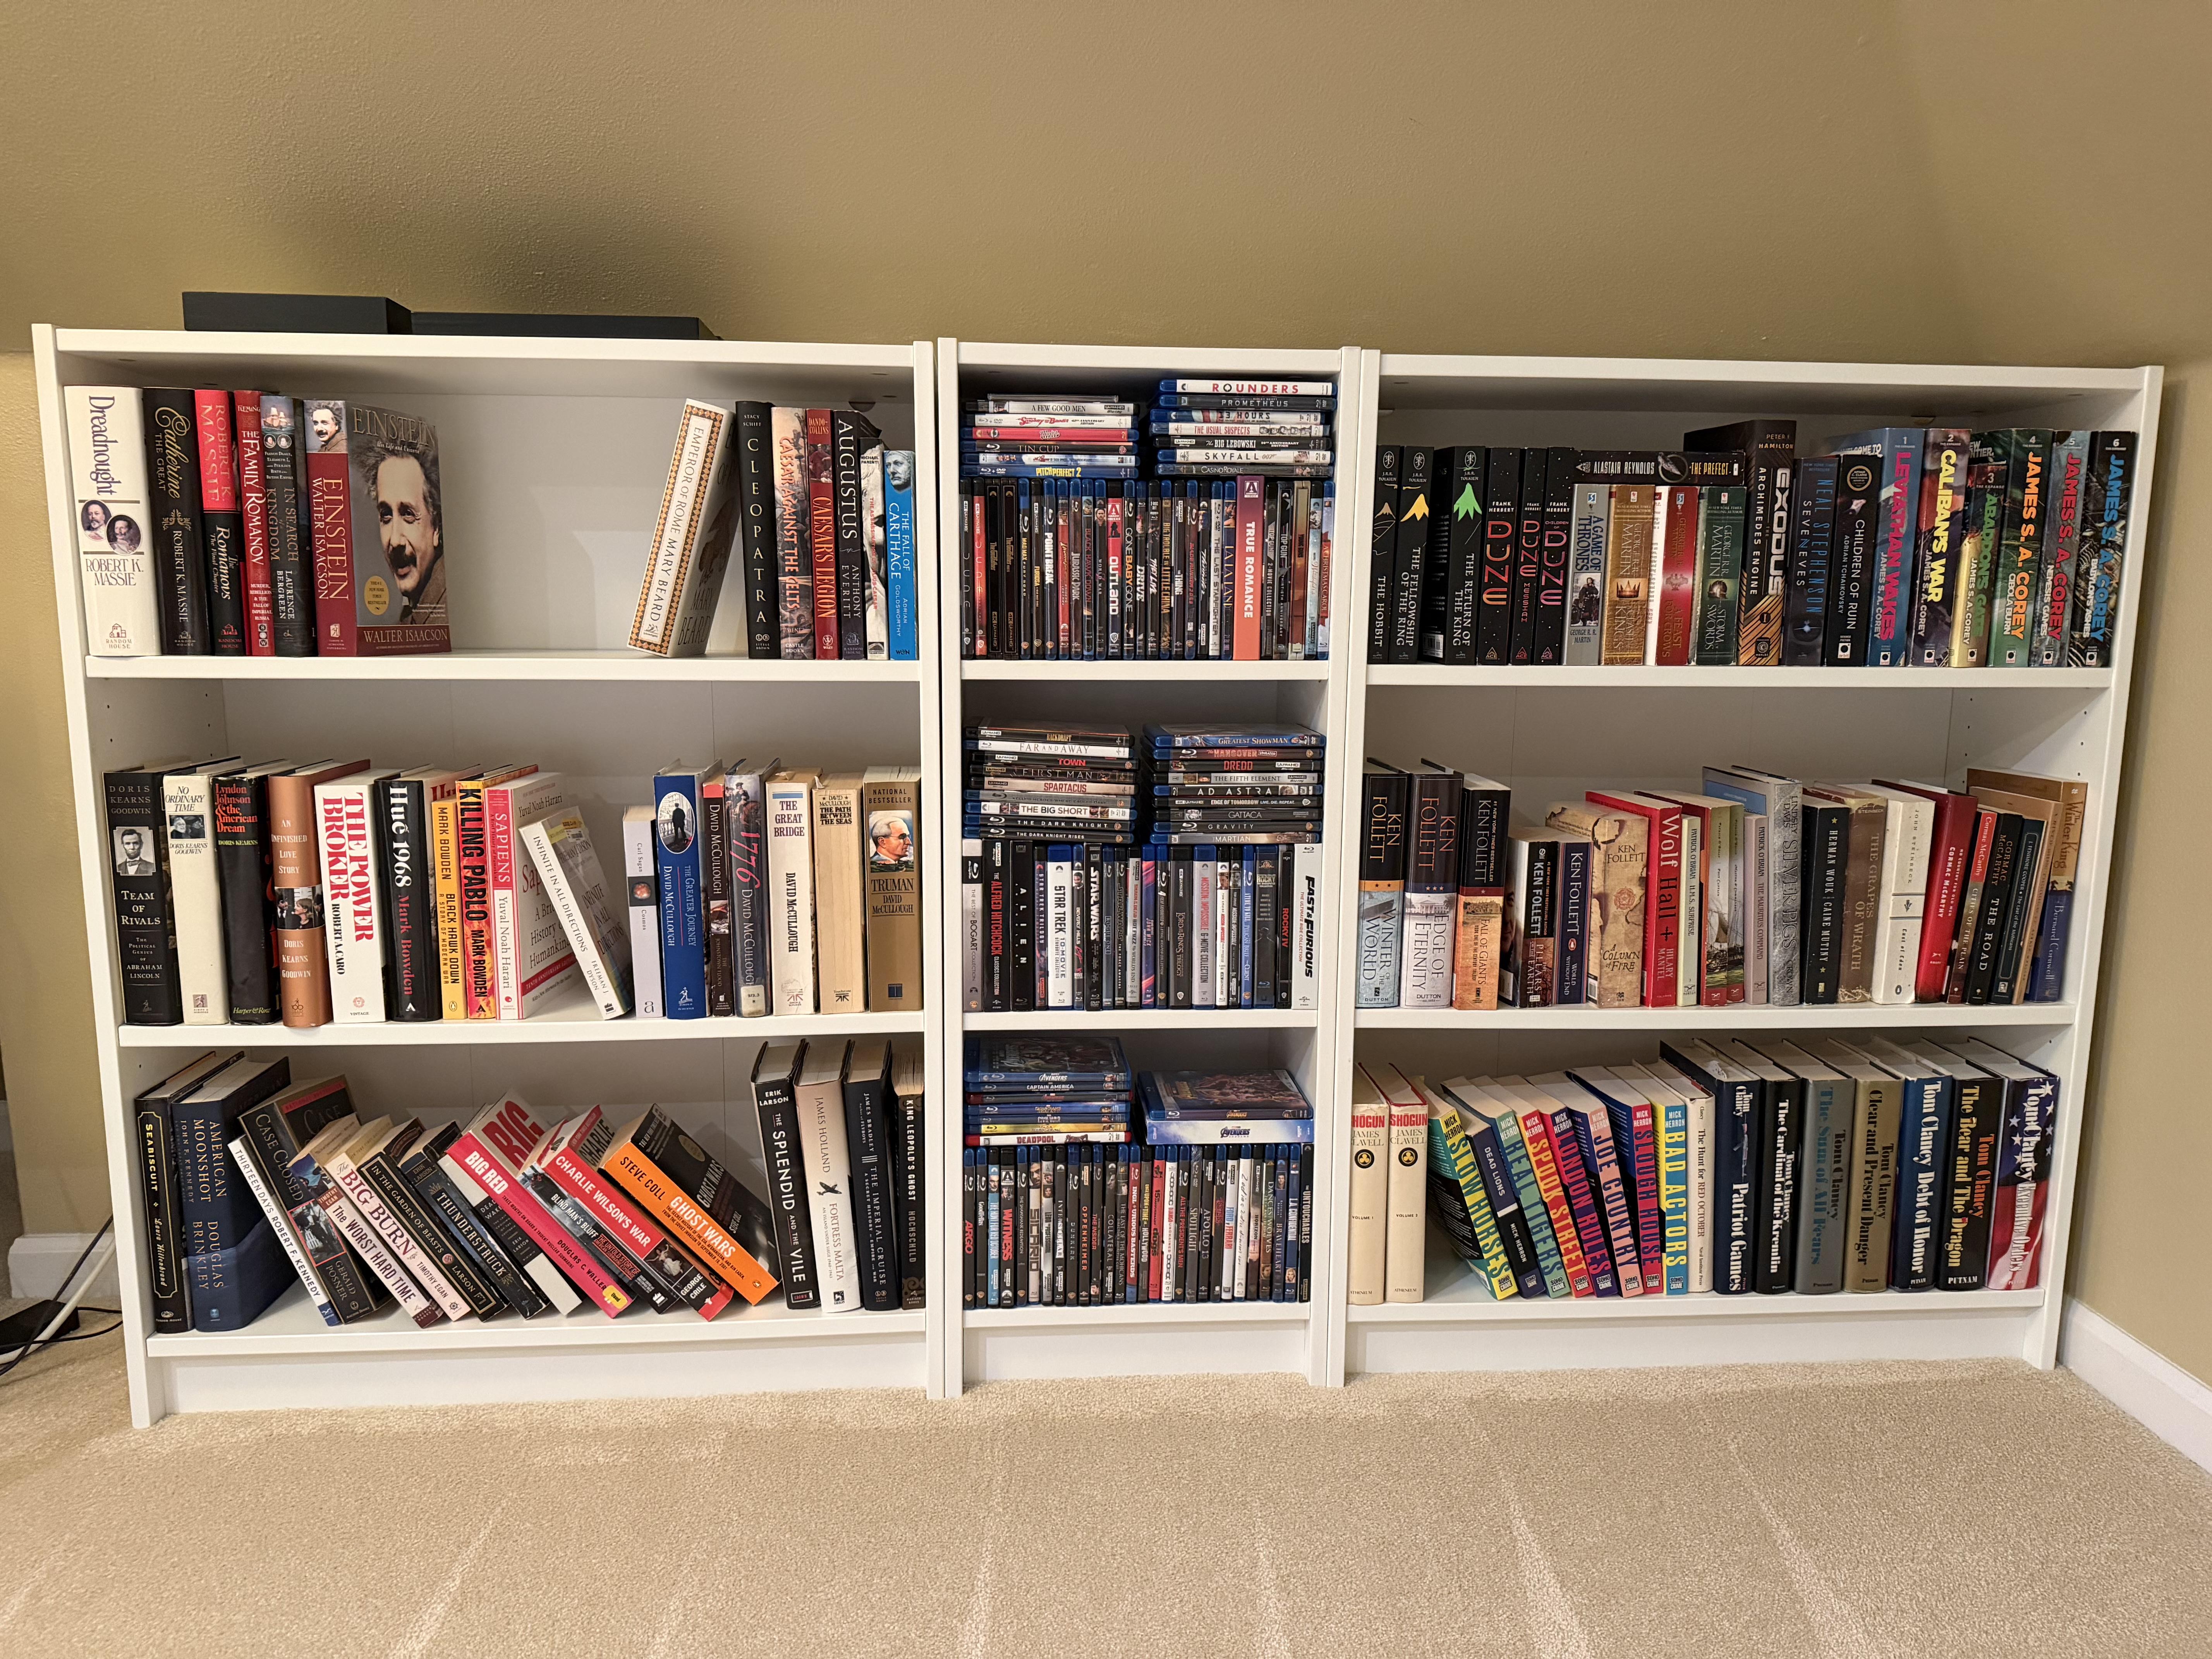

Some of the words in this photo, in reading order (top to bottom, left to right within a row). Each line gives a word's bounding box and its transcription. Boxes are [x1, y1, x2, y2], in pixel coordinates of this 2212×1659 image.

[1212, 383, 1298, 393] ROUNDERS
[1221, 399, 1288, 407] PROMETHEUS
[88, 395, 117, 496] Dreadnought
[1194, 426, 1204, 434] THE
[1206, 425, 1222, 434] USUAL
[1224, 426, 1250, 434] SUSPECTS
[1215, 440, 1226, 448] BIG
[1228, 440, 1256, 448] LEBOWSKI
[155, 407, 190, 499] Catherine
[242, 440, 260, 489] FAMILY
[678, 427, 704, 485] EMPEROR
[1205, 452, 1259, 461] SKYFALL
[1594, 462, 1621, 474] ALASTAIR
[1625, 462, 1655, 474] REYNOLDS
[1691, 463, 1702, 475] THE
[1704, 463, 1728, 475] PREFECT
[680, 486, 689, 500] OF
[838, 418, 858, 539] AUGUSTUS
[312, 477, 324, 523] WALTER
[669, 501, 685, 536] ROME
[1886, 452, 1911, 568] LEVIATHAN
[1932, 450, 1957, 553] CALIBAN'S
[246, 486, 266, 565] ROMANOV
[323, 477, 349, 601] EINSTEIN
[747, 438, 766, 623] CLEOPATRA
[888, 502, 902, 579] CARTHAGE
[1245, 521, 1256, 549] TRUE
[1767, 467, 1791, 596] EXODUS
[1796, 500, 1812, 587] SEVENEVES
[86, 558, 130, 573] ROBERT
[131, 559, 144, 572] K.
[314, 526, 329, 600] ISAACSON
[657, 538, 677, 576] MARY
[1071, 553, 1079, 582] JURASSIC
[94, 573, 136, 586] MASSIE
[815, 562, 837, 618] LEGION
[1136, 565, 1144, 602] DRIVE
[1244, 551, 1256, 619] ROMANCE
[1376, 575, 1386, 598] THE
[1927, 555, 1947, 602] WAR
[647, 578, 668, 622] BEARD
[1880, 567, 1900, 640] WAKES
[1374, 600, 1385, 647] HOBBIT
[1058, 758, 1086, 766] TOWN
[1223, 761, 1253, 770] DREDD
[165, 795, 205, 804] ORDINARY
[177, 786, 189, 794] NO
[780, 800, 797, 810] THE
[1044, 782, 1087, 792] SPARTACUS
[1228, 787, 1271, 796] ASTRA
[174, 804, 195, 812] TIME
[344, 792, 367, 850] THE
[459, 788, 484, 857] KILLING
[775, 814, 802, 824] GREAT
[1021, 805, 1039, 814] THE
[1041, 806, 1055, 814] BIG
[1057, 807, 1087, 815] SHORT
[2064, 800, 2084, 836] Winter
[323, 796, 350, 900] BROKER
[495, 812, 510, 882] SAPIENS
[774, 827, 805, 836] BRIDGE
[1369, 796, 1387, 863] FOLLETT
[1386, 813, 1402, 846] KEN
[1660, 814, 1680, 868] Wolf
[1829, 830, 1838, 864] HERMAN
[729, 831, 761, 889] 1776
[1908, 835, 1917, 884] STEINBECK
[2060, 837, 2078, 869] King
[348, 854, 374, 942] POWER
[463, 865, 488, 921] PABLO
[534, 837, 553, 873] INFINITE
[550, 874, 558, 884] IN
[555, 884, 566, 902] ALL
[563, 904, 587, 952] DIRECTIONS
[871, 879, 914, 891] TRUMAN
[991, 880, 1000, 913] ALFRED
[1053, 885, 1065, 908] STAR
[1658, 876, 1678, 919] Hall
[1825, 869, 1834, 897] WOUK
[132, 904, 145, 913] OF
[498, 897, 508, 922] Yuval
[1054, 909, 1066, 935] TREK
[1986, 898, 2000, 926] THE
[500, 924, 509, 951] Noah
[991, 914, 1002, 955] HITCHCOCK
[1281, 938, 1288, 948] IV
[1978, 932, 1994, 971] ROAD
[502, 952, 512, 989] Harari
[759, 1096, 788, 1106] LARSON
[1668, 1110, 1682, 1119] MICK
[1922, 1081, 1942, 1113] Tom
[1017, 1135, 1056, 1144] DEADPOOL
[1390, 1137, 1427, 1145] CLAVELL
[1395, 1129, 1423, 1137] JAMES
[1665, 1118, 1685, 1128] HERRON
[1913, 1116, 1939, 1167] Clancy
[146, 1124, 158, 1191] SEABISCUIT
[194, 1119, 211, 1202] MOONSHOT
[210, 1121, 227, 1197] AMERICAN
[256, 1113, 279, 1151] CASE
[273, 1150, 304, 1202] CLOSED
[906, 1124, 914, 1170] LEOPOLD'S
[1665, 1131, 1686, 1170] BAD
[465, 1151, 488, 1178] BIG
[481, 1170, 508, 1195] RED
[772, 1130, 795, 1210] SPLENDID
[1484, 1146, 1496, 1169] DEAD
[1491, 1170, 1506, 1196] LIONS
[555, 1155, 594, 1194] CHARLIE
[594, 1189, 632, 1229] WILSON'S
[627, 1224, 651, 1248] WAR
[1449, 1139, 1476, 1199] SLOW
[1470, 1200, 1509, 1278] HORSES
[1913, 1171, 1936, 1209] Debt
[340, 1165, 372, 1209] BIG
[368, 1204, 416, 1256] BURN
[669, 1196, 705, 1233] GHOST
[702, 1225, 737, 1258] WARS
[1188, 1207, 1197, 1252] SPOTLIGHT
[1301, 1190, 1310, 1243] UNTOUCHABLES
[1665, 1183, 1687, 1267] ACTORS
[1731, 1182, 1750, 1238] Patriot
[1914, 1211, 1925, 1223] of
[964, 1221, 974, 1254] ARGO
[1029, 1209, 1040, 1272] SICARIO
[1274, 1224, 1283, 1274] BRAVEHEART
[1910, 1225, 1930, 1274] Honor
[789, 1249, 805, 1282] VILE
[1728, 1241, 1747, 1291] Games
[1948, 1276, 1978, 1284] PUTNAM
